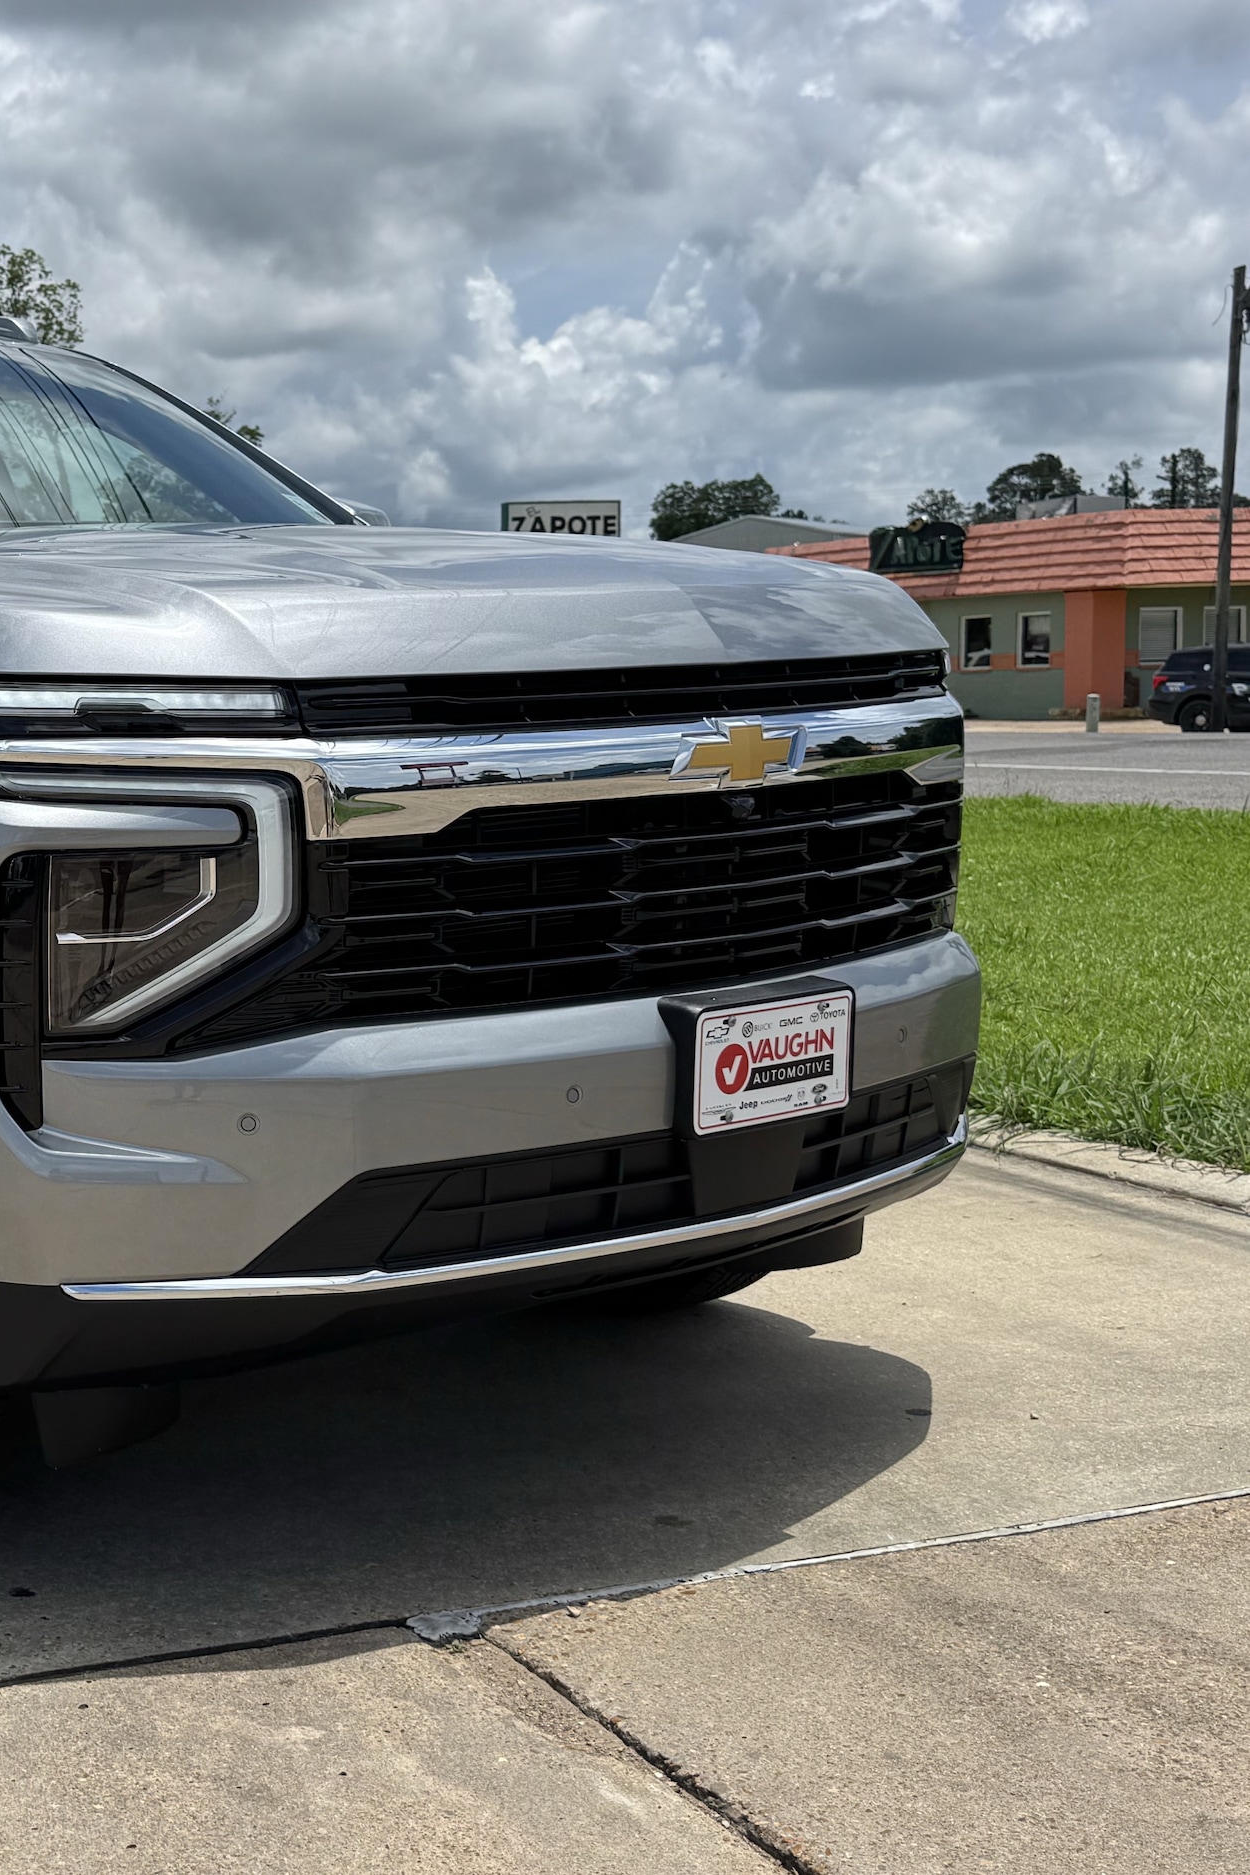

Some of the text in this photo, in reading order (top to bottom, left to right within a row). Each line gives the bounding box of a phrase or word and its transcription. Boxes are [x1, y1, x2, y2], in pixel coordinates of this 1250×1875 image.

[526, 506, 541, 518] EL
[511, 515, 616, 536] ZAPOTE
[820, 1009, 846, 1020] TOYOTA
[754, 1022, 772, 1032] BUICK
[779, 1016, 803, 1027] GMC
[747, 1027, 835, 1064] VAUGHN
[753, 1059, 831, 1085] AUTOMOTIVE
[739, 1101, 758, 1110] Jeep
